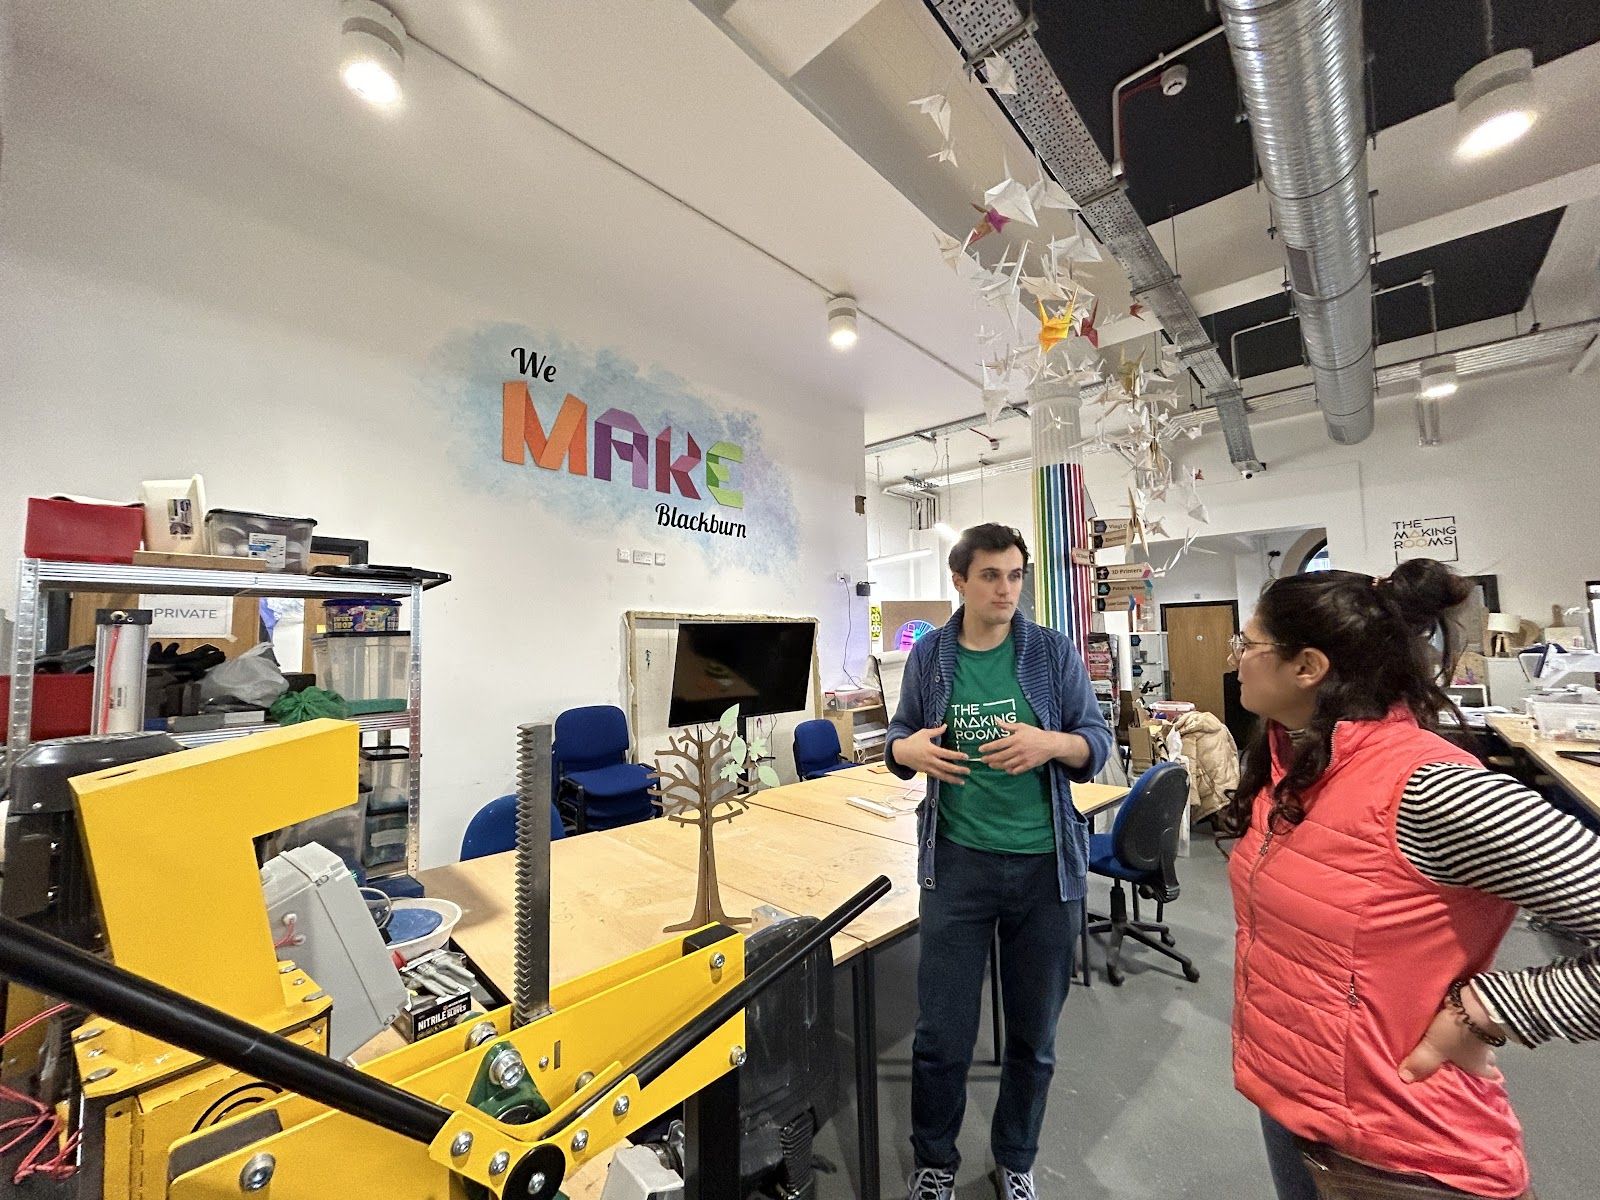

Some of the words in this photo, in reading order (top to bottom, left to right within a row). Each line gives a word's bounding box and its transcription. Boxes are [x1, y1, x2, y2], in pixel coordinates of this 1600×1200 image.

[511, 347, 557, 382] We
[502, 380, 744, 509] MAKE
[655, 502, 747, 538] Blackburn
[1392, 519, 1422, 530] THE
[1393, 526, 1456, 540] MAKING
[1393, 536, 1453, 549] ROOMS
[154, 608, 217, 619] PRIVATE
[951, 704, 980, 716] THE
[953, 712, 1017, 729] MAKING
[955, 727, 1011, 740] ROOMS
[417, 1010, 447, 1031] NITRILE
